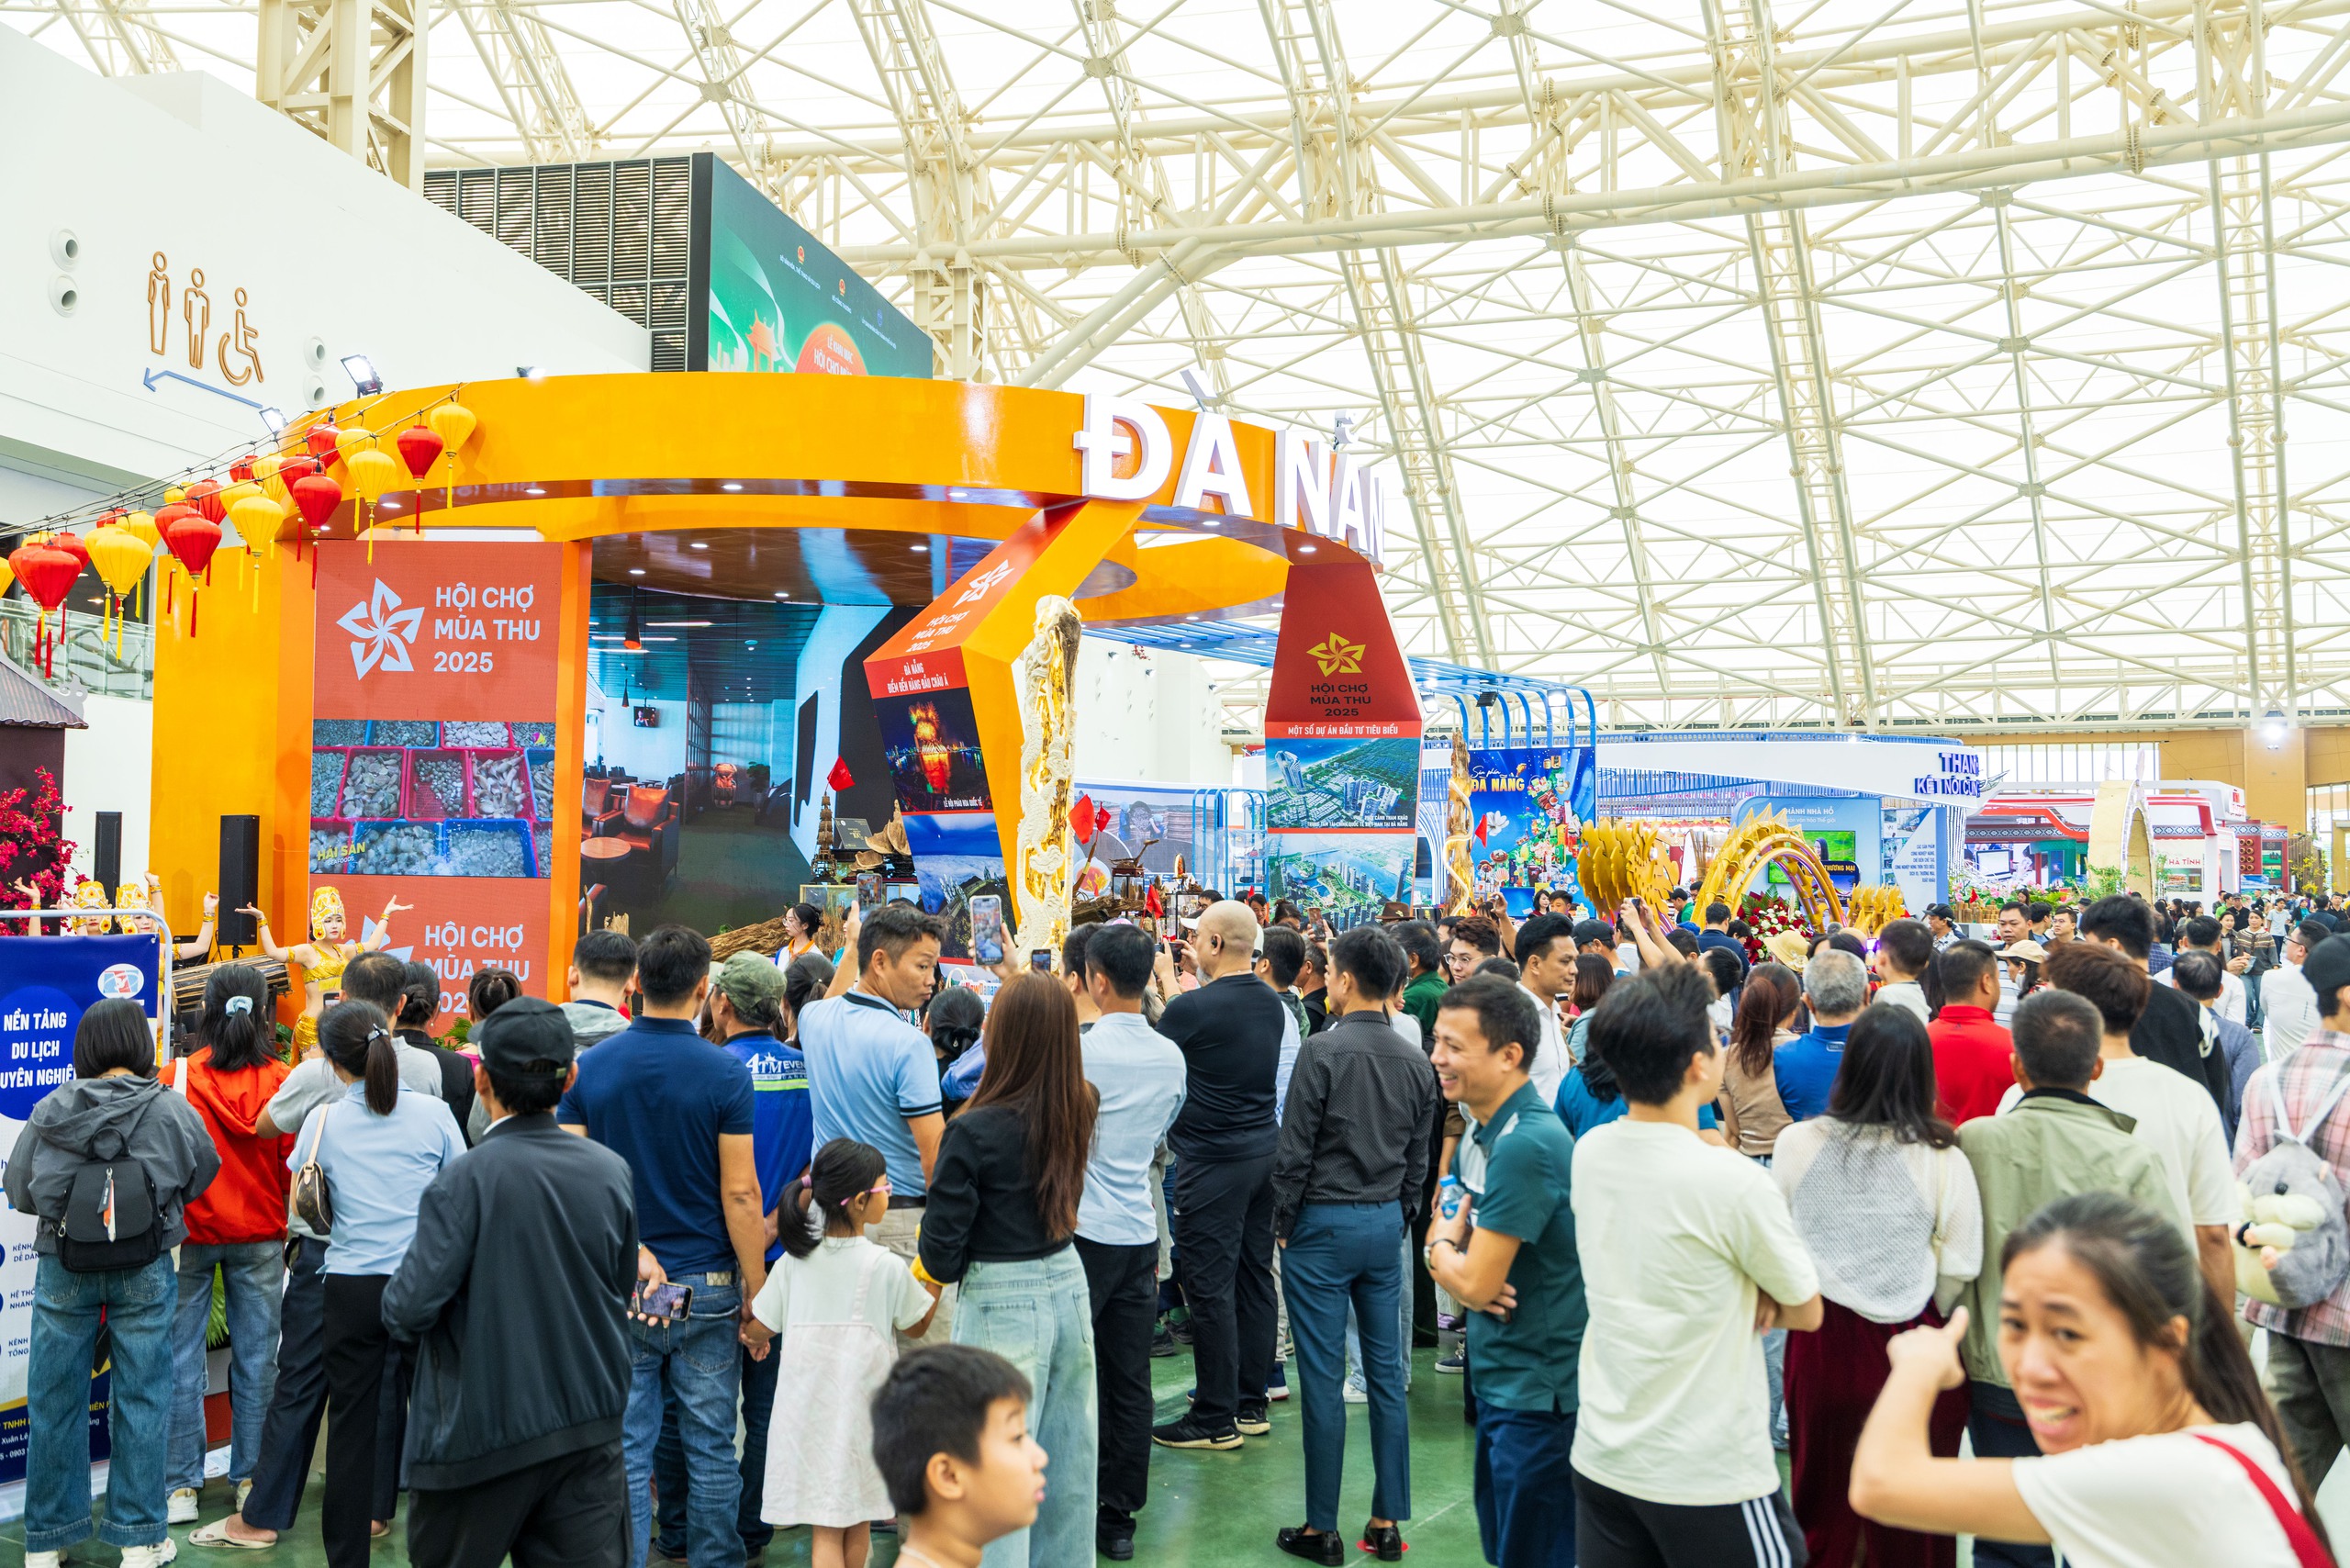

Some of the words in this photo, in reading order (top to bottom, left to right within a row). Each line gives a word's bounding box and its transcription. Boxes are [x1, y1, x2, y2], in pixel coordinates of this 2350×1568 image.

[813, 348, 825, 370] HỘI
[1073, 369, 1254, 518] ĐÀ
[435, 581, 476, 612] HỘI
[482, 584, 534, 613] CHỢ
[926, 614, 946, 627] HỘI
[945, 610, 970, 624] CHỢ
[434, 614, 487, 640] MÙA
[493, 619, 541, 641] THU
[912, 628, 935, 640] MÙA
[934, 625, 957, 636] THU
[433, 651, 494, 673] 2025
[903, 662, 912, 676] ĐÀ
[911, 658, 924, 675] NẴNG
[1311, 682, 1335, 695] HỘI
[1337, 683, 1369, 694] CHỢ
[1310, 695, 1340, 704] MÙA
[1344, 696, 1371, 704] THU
[1325, 708, 1360, 717] 2025
[1288, 724, 1303, 736] MỘT
[1304, 722, 1315, 735] SỐ
[1315, 725, 1326, 736] DỰ
[1327, 724, 1337, 735] ÁN
[1338, 722, 1353, 735] ĐẦU
[1355, 725, 1365, 734] TƯ
[1365, 724, 1381, 734] TIÊU
[1382, 722, 1398, 734] BIỂU
[1939, 752, 1979, 776] THAN
[1471, 776, 1487, 792] ĐÀ
[1491, 774, 1525, 792] NẴNG
[1915, 774, 1942, 794] KẾT
[1942, 775, 1961, 795] NỐI
[1961, 777, 1981, 798] CÙN
[1785, 806, 1805, 815] HÀNH
[1807, 807, 1821, 815] NHÀ
[318, 845, 338, 861] HẢI
[341, 841, 365, 857] SẢN
[425, 921, 465, 952] HỘI
[471, 924, 524, 953] CHỢ
[424, 954, 475, 980] MÙA
[4, 1008, 29, 1032] NỀN
[33, 1008, 67, 1029] TẢNG
[11, 1042, 28, 1059] DU
[31, 1040, 60, 1062] LỊCH
[12, 1242, 32, 1252] KÊNH
[10, 1289, 19, 1299] HỆ
[9, 1301, 33, 1309] NHAN
[8, 1338, 28, 1347] KÊNH
[7, 1347, 29, 1358] TỔNG
[3, 1417, 27, 1430] TNHH
[1, 1435, 18, 1446] Xuân
[9, 1448, 26, 1458] 0903
